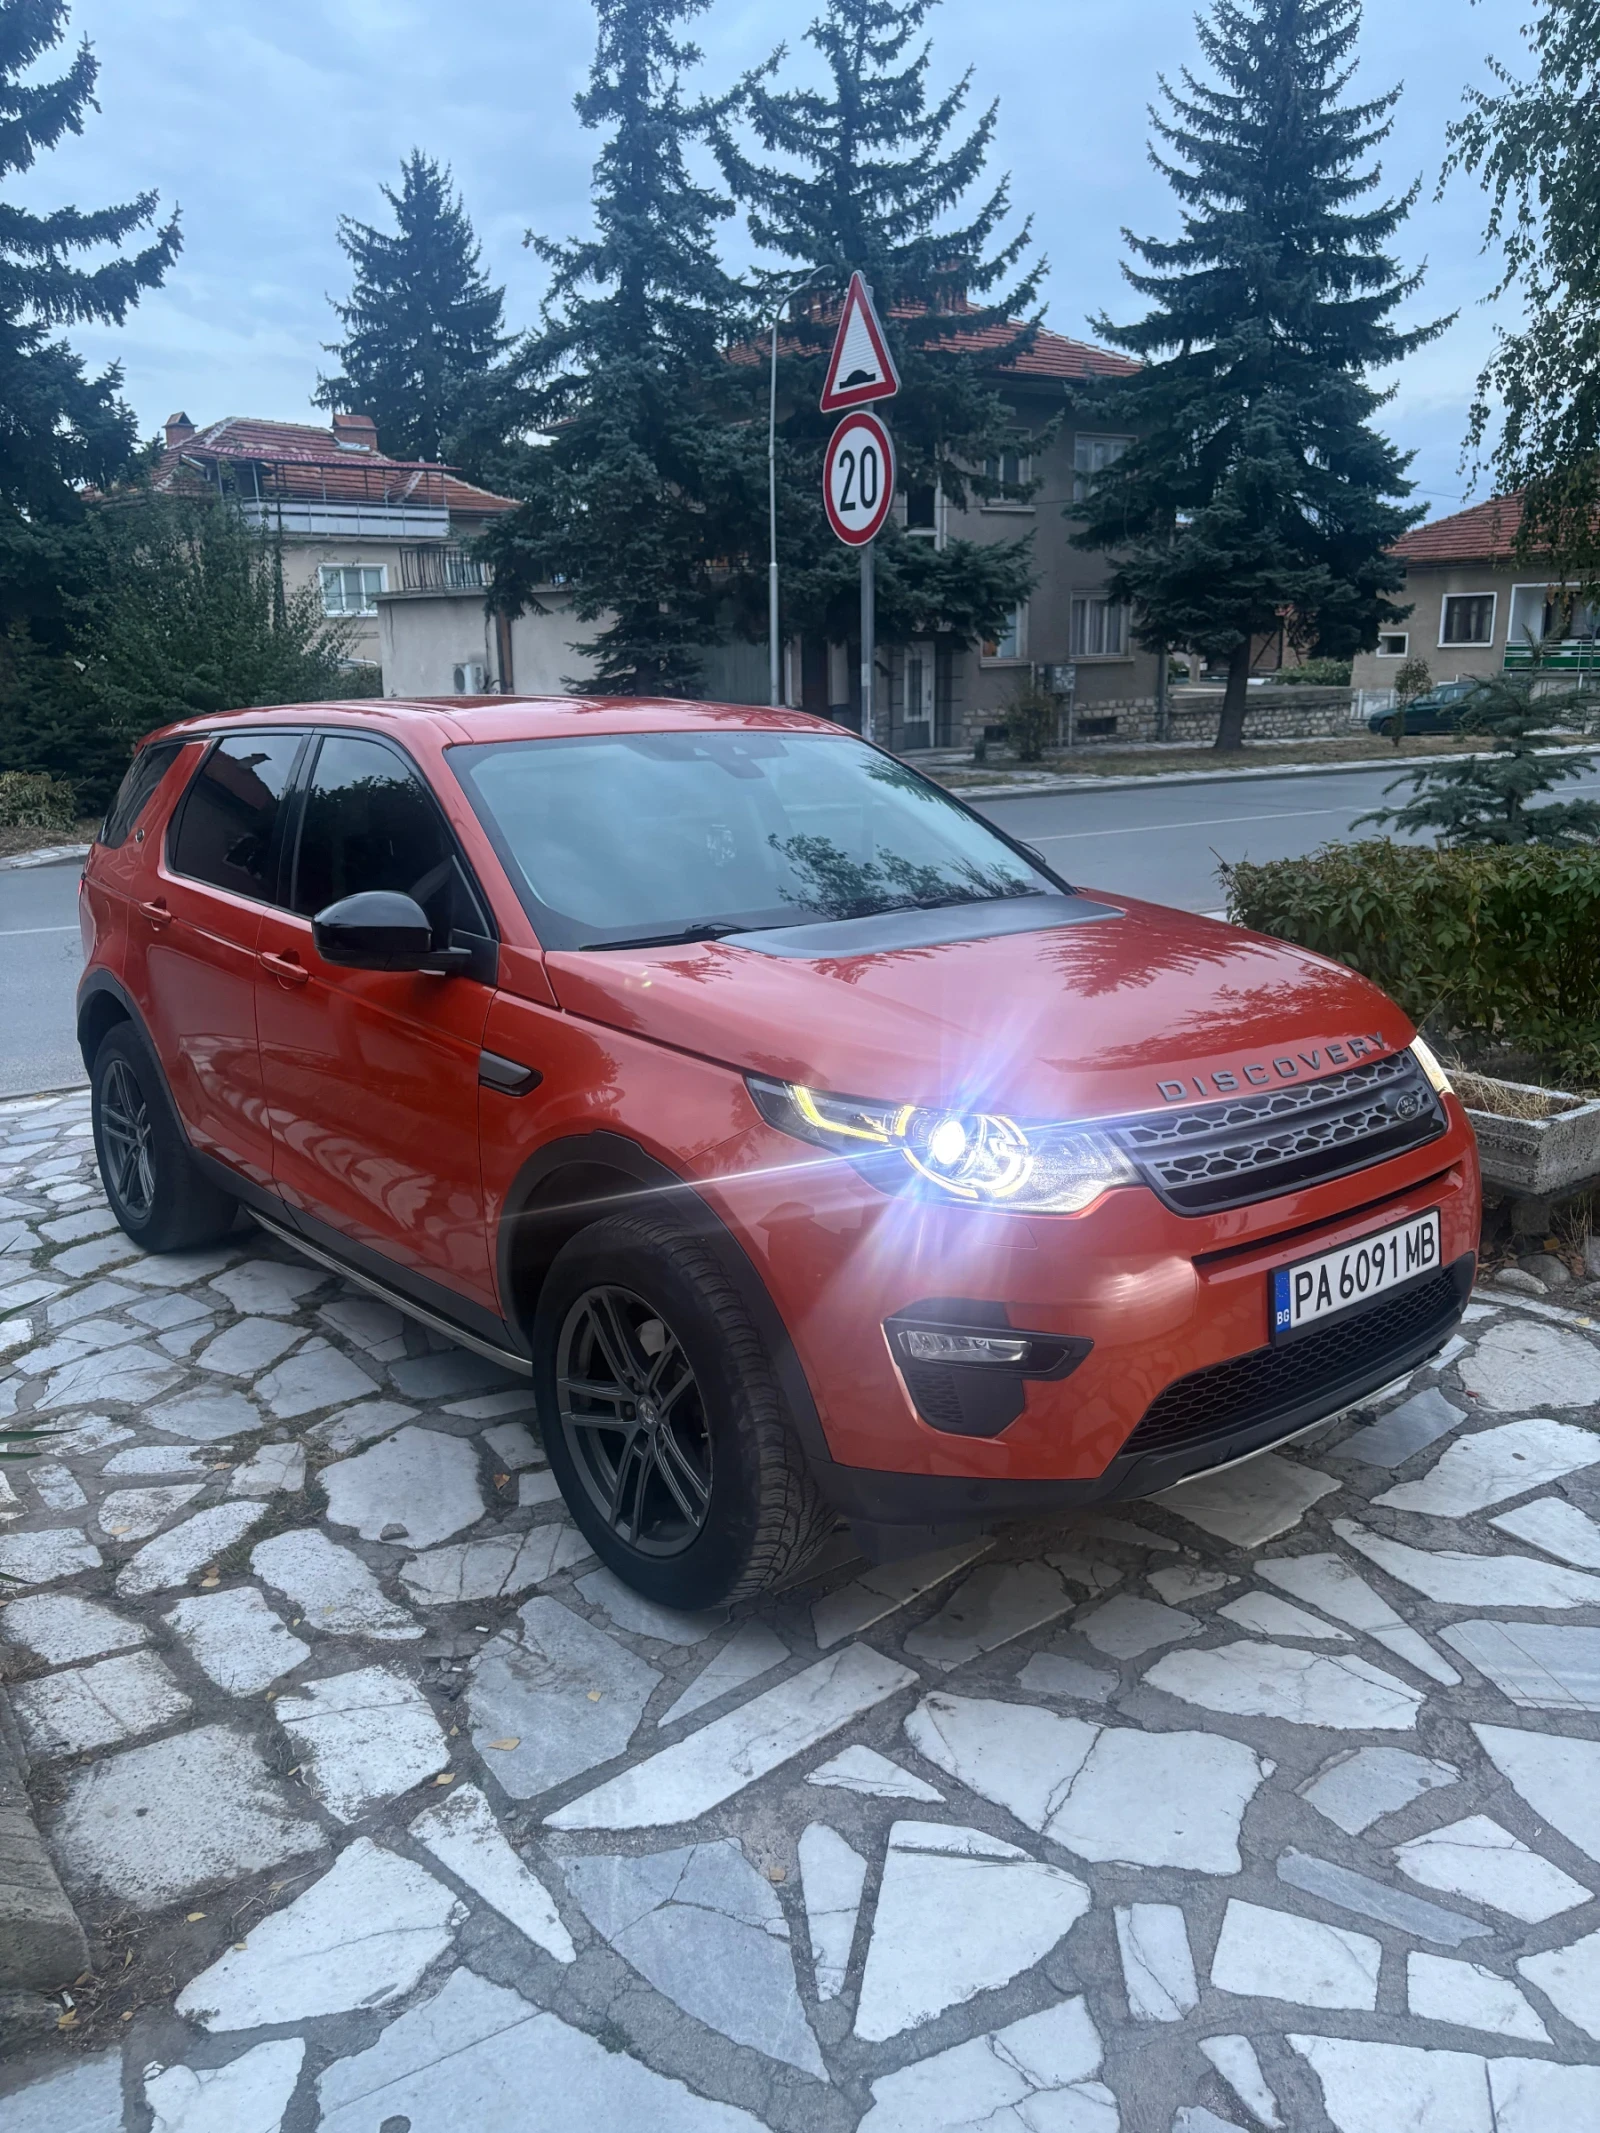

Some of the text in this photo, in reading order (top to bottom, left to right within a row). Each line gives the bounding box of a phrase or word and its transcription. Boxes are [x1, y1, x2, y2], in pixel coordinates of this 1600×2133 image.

[839, 445, 877, 512] 20
[1157, 1031, 1386, 1101] DISCOVERY
[1295, 1221, 1435, 1319] PA 6091 MB
[1276, 1308, 1290, 1325] BG
